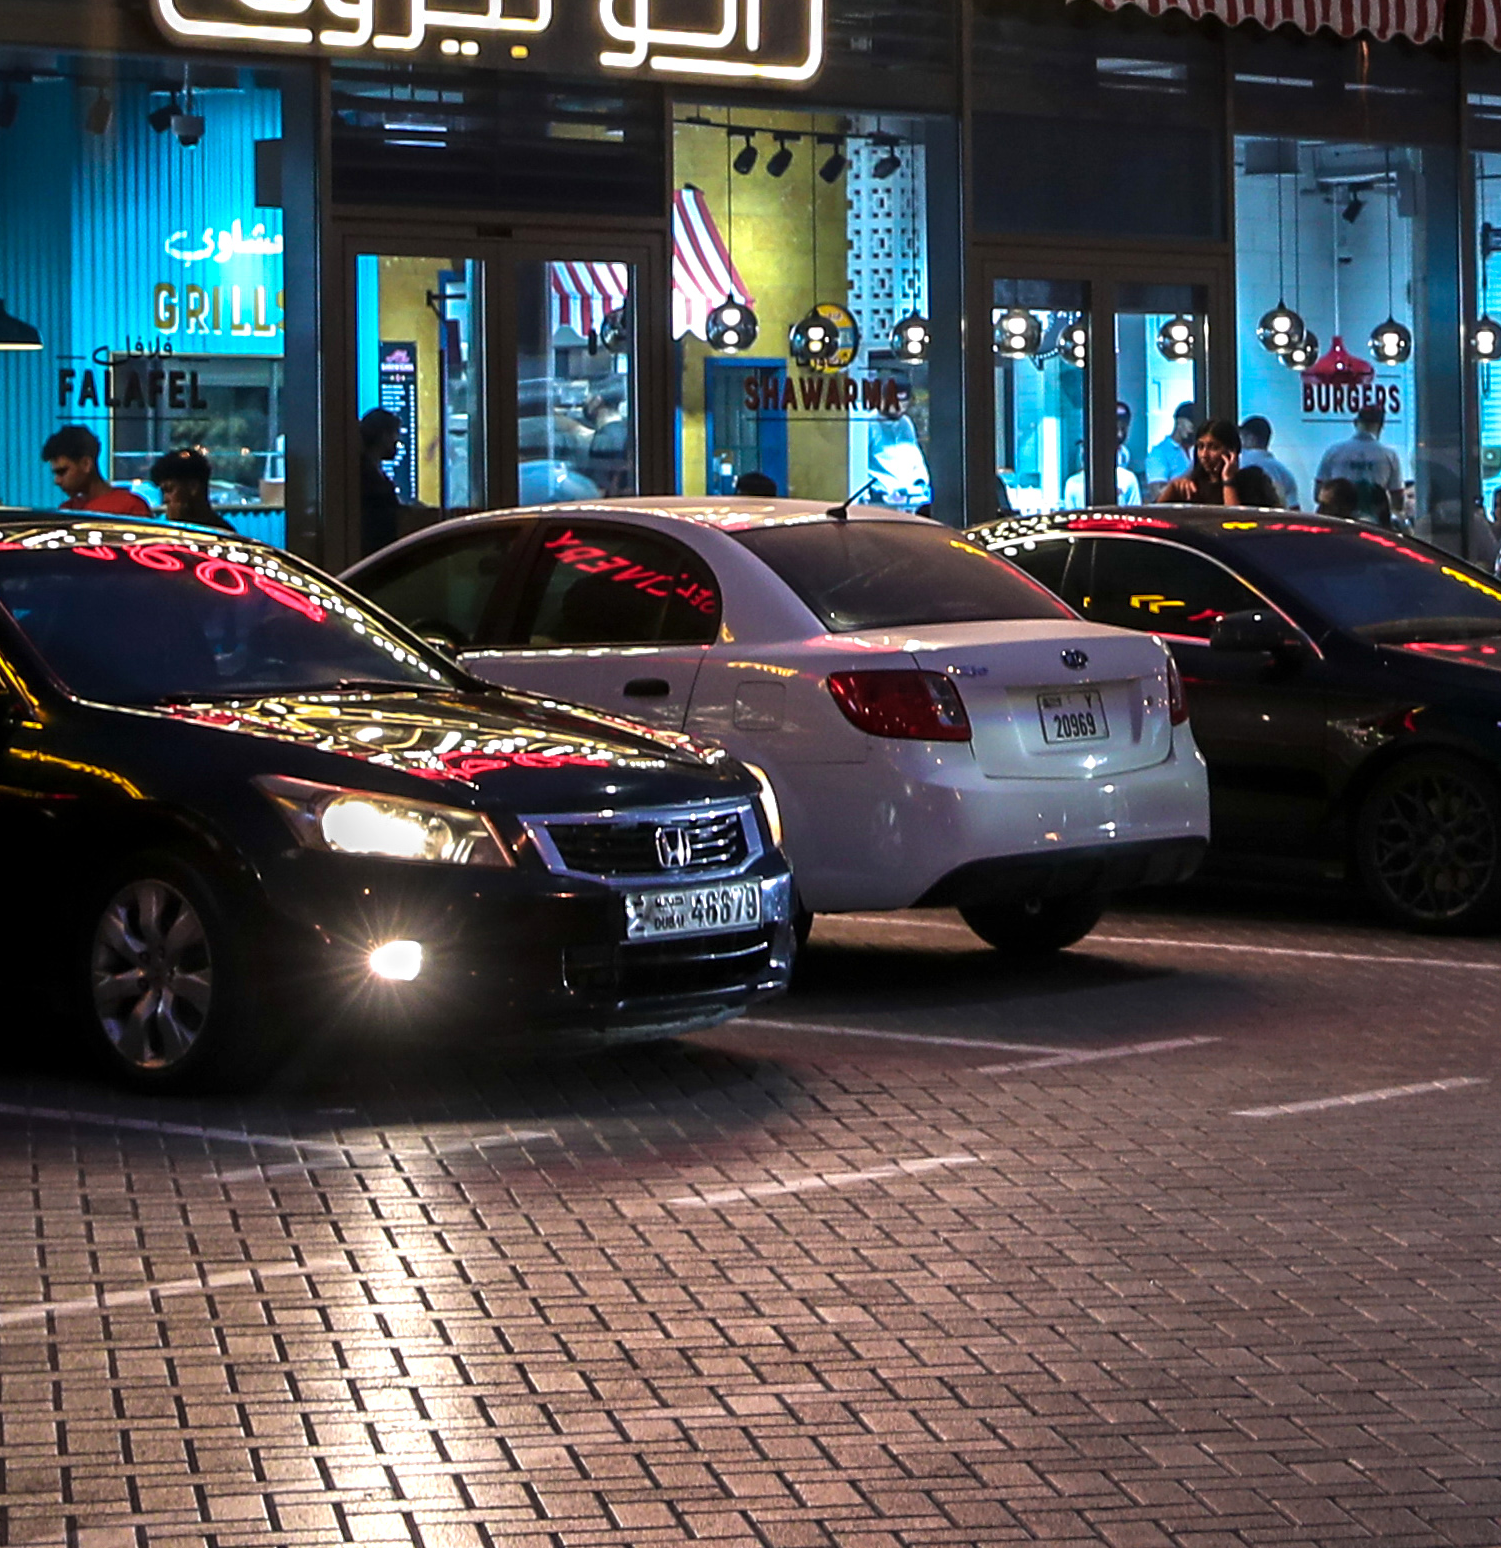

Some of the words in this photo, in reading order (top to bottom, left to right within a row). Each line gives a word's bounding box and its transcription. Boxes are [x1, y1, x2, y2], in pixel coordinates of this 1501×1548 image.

[57, 368, 208, 409] FALAFEL
[743, 376, 900, 411] SHAWARMA
[1303, 383, 1400, 413] BURGERS
